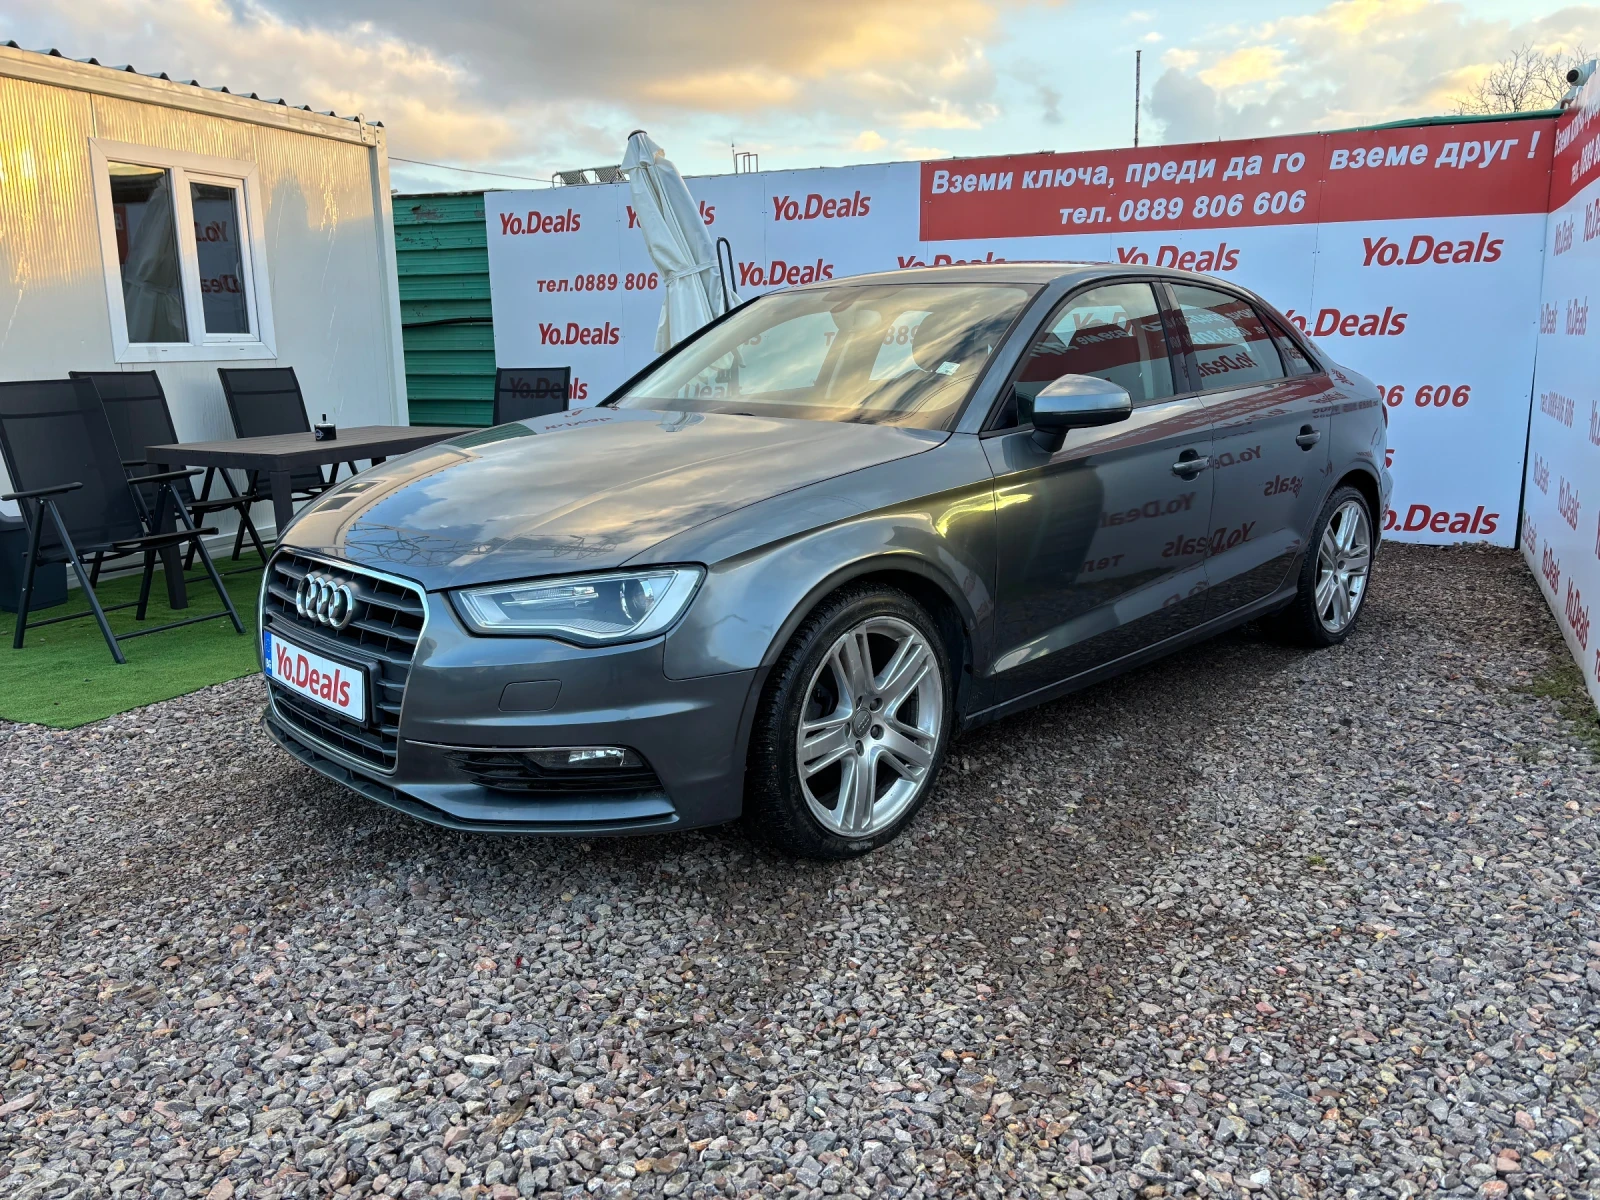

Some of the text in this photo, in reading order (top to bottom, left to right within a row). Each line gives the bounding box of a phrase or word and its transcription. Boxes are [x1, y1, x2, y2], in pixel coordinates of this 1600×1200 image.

[932, 169, 1013, 194] Вземи
[1021, 165, 1115, 189] ключа,
[1125, 157, 1216, 188] преди
[1223, 153, 1263, 181] да
[1273, 152, 1305, 173] го
[1329, 143, 1428, 170] вземе
[1435, 139, 1518, 169] друг
[773, 190, 871, 220] Yo.Deals
[1059, 190, 1306, 224] тел. 0889 806 606
[500, 208, 581, 235] Yo.Deals
[1117, 242, 1240, 272] YoDeals
[1362, 232, 1505, 266] Yo.Deals
[537, 272, 658, 293] тел.0889 806
[738, 258, 834, 287] Yo.Deals
[539, 322, 619, 345] Yo.Deals
[1285, 306, 1408, 337] o.Deals
[1415, 385, 1471, 407] 606
[1384, 504, 1500, 534] o.Deals
[276, 643, 350, 707] Yo.Deals
